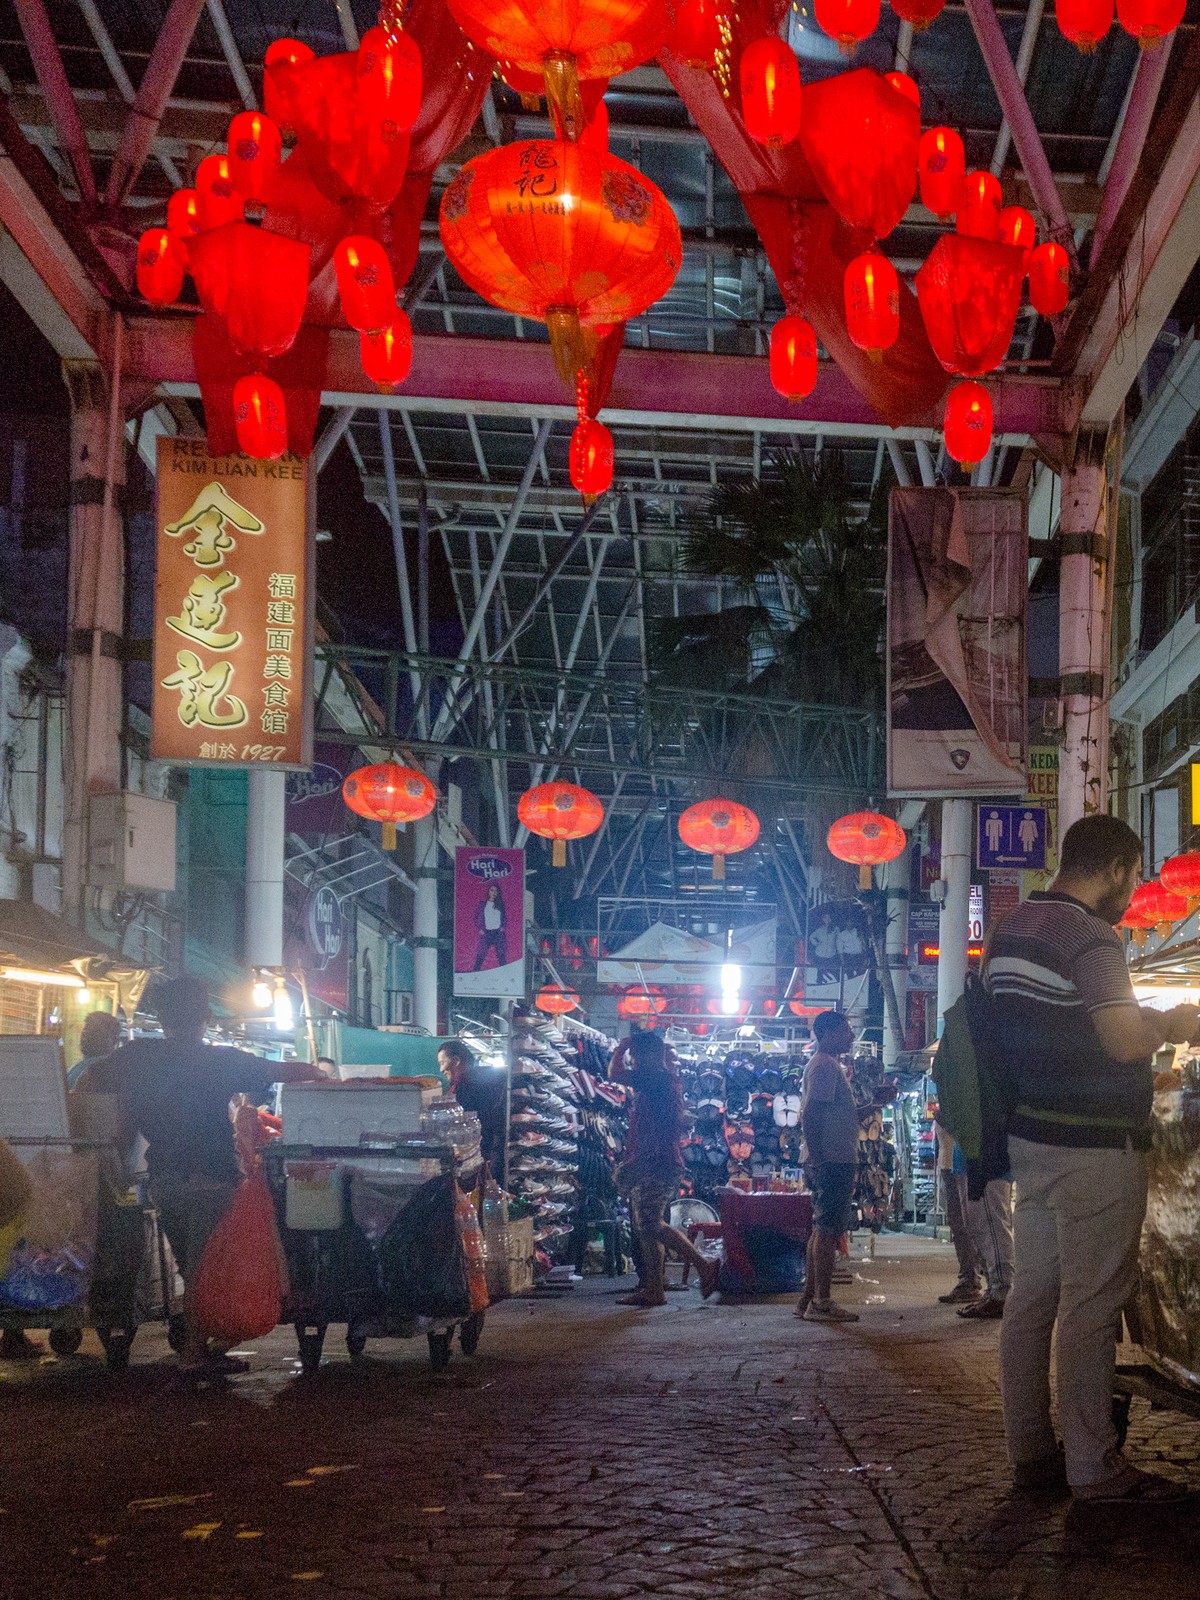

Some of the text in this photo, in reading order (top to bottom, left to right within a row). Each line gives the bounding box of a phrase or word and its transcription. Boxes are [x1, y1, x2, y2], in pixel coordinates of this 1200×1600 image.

[173, 459, 303, 480] KIM LIAN KEE
[240, 744, 287, 761] 1927
[470, 859, 495, 870] Hari
[484, 868, 508, 878] Hari
[969, 886, 982, 898] EL
